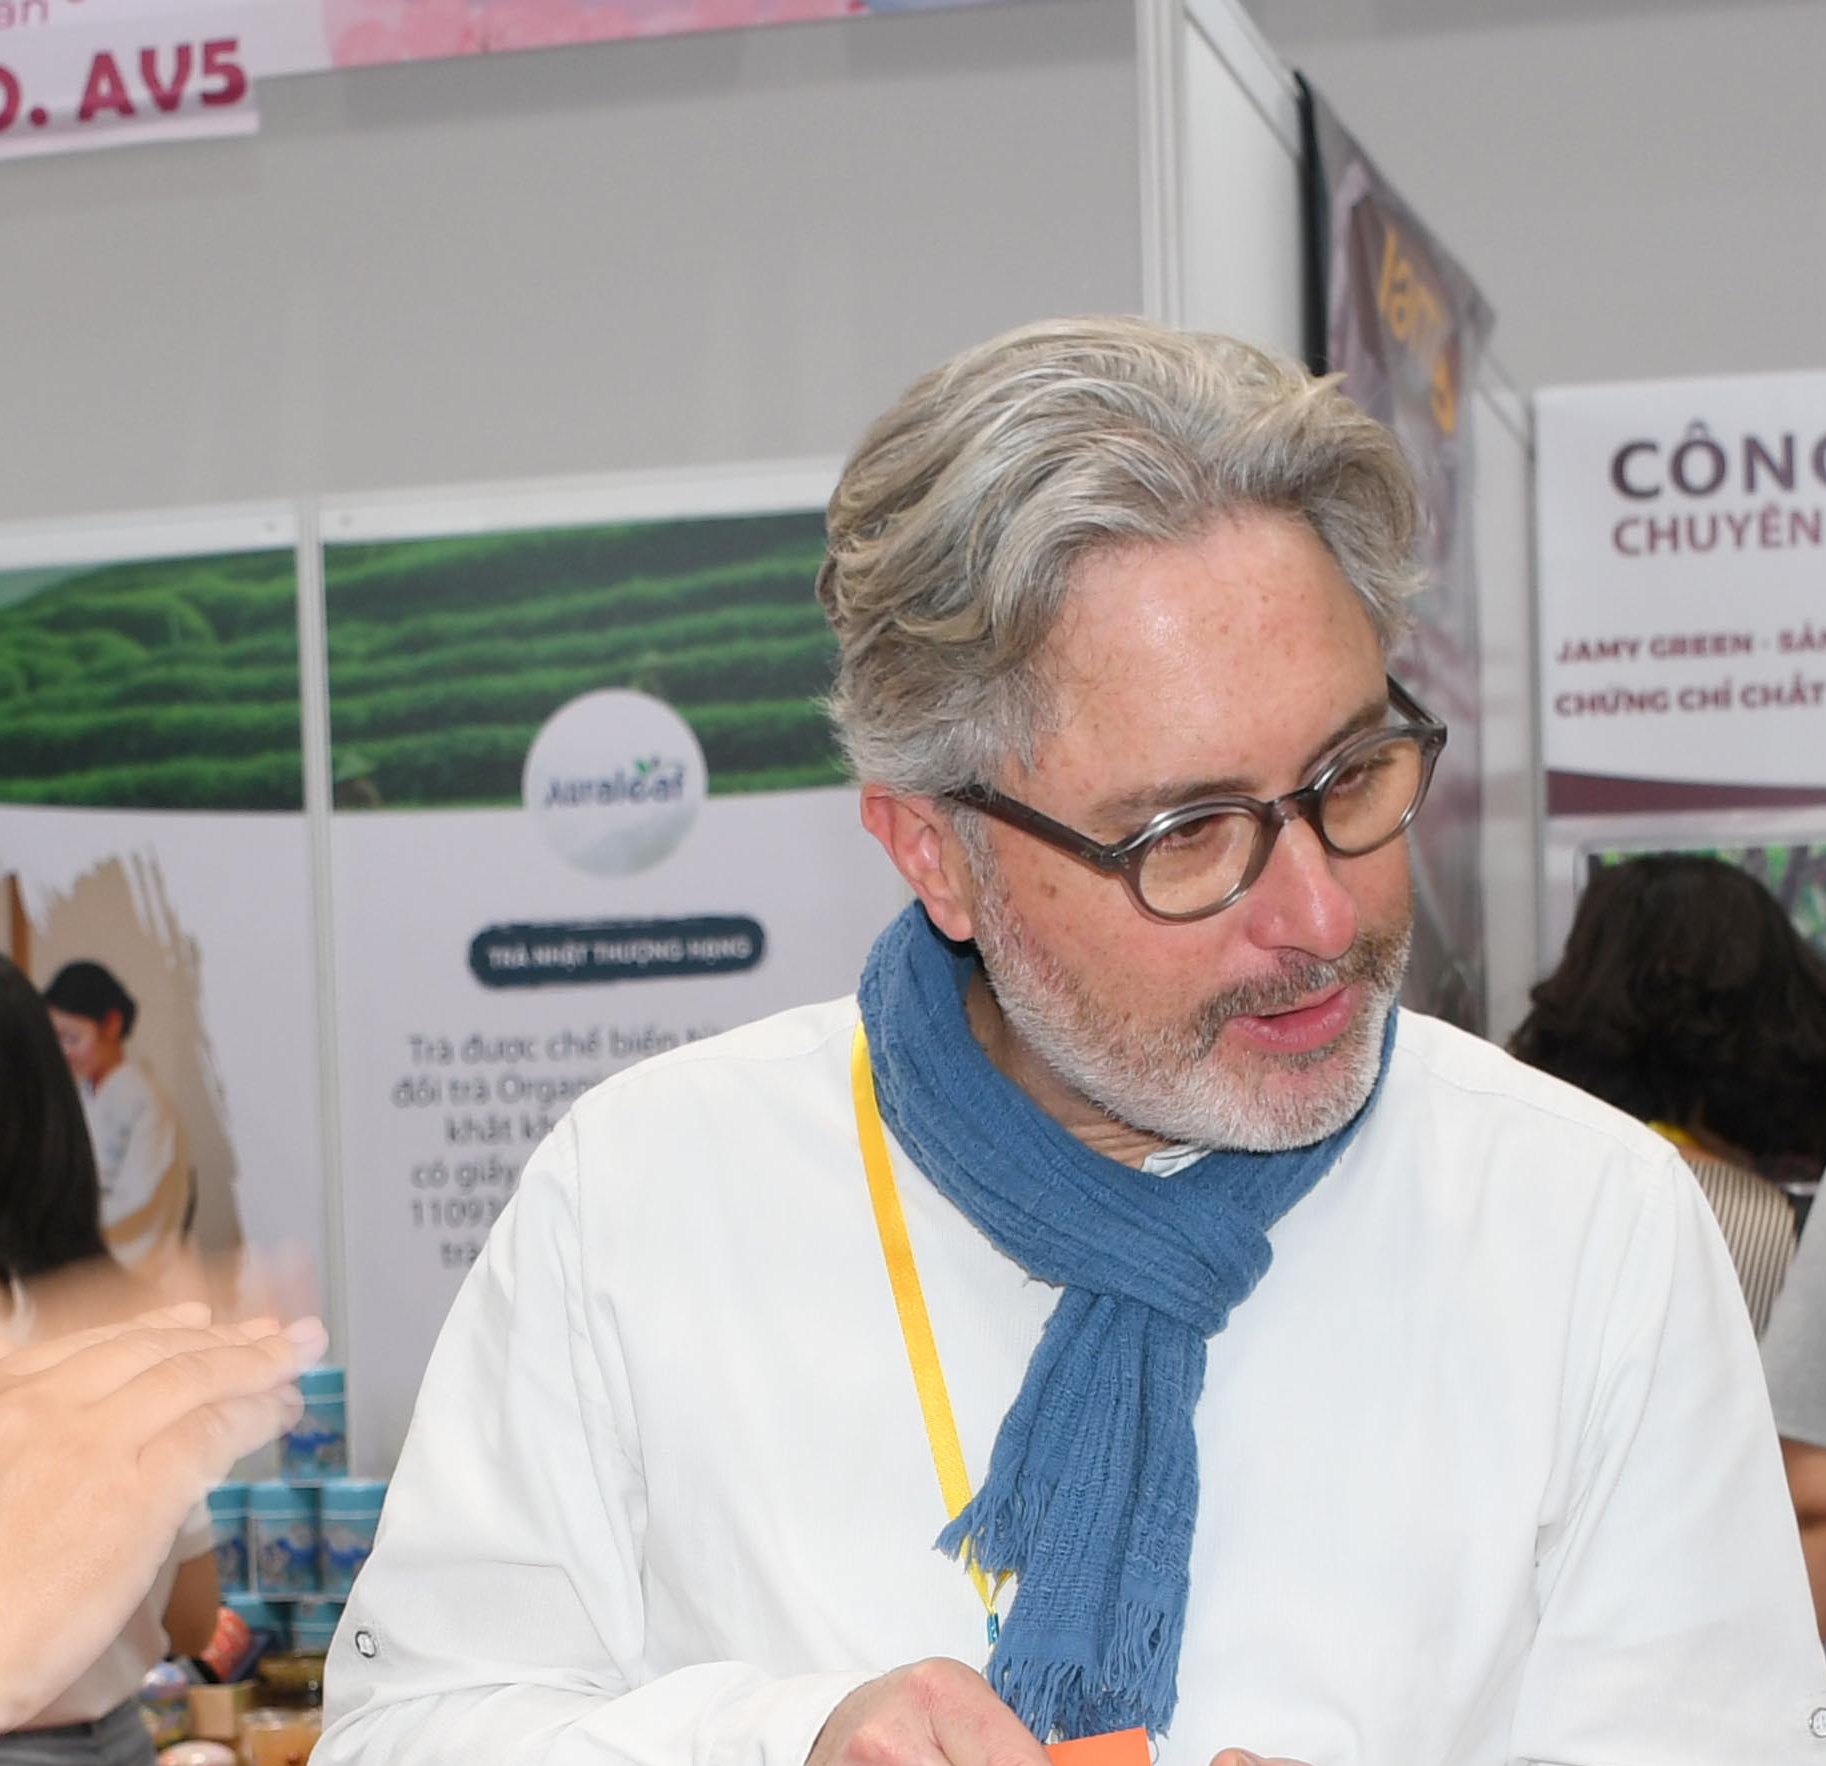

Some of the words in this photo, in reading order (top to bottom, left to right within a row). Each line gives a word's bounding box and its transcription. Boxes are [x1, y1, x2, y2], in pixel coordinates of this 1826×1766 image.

[77, 38, 248, 124] AV5
[1612, 503, 1825, 558] CHUYÊN
[1556, 635, 1642, 665] JAMY
[1648, 630, 1754, 660] GREEN
